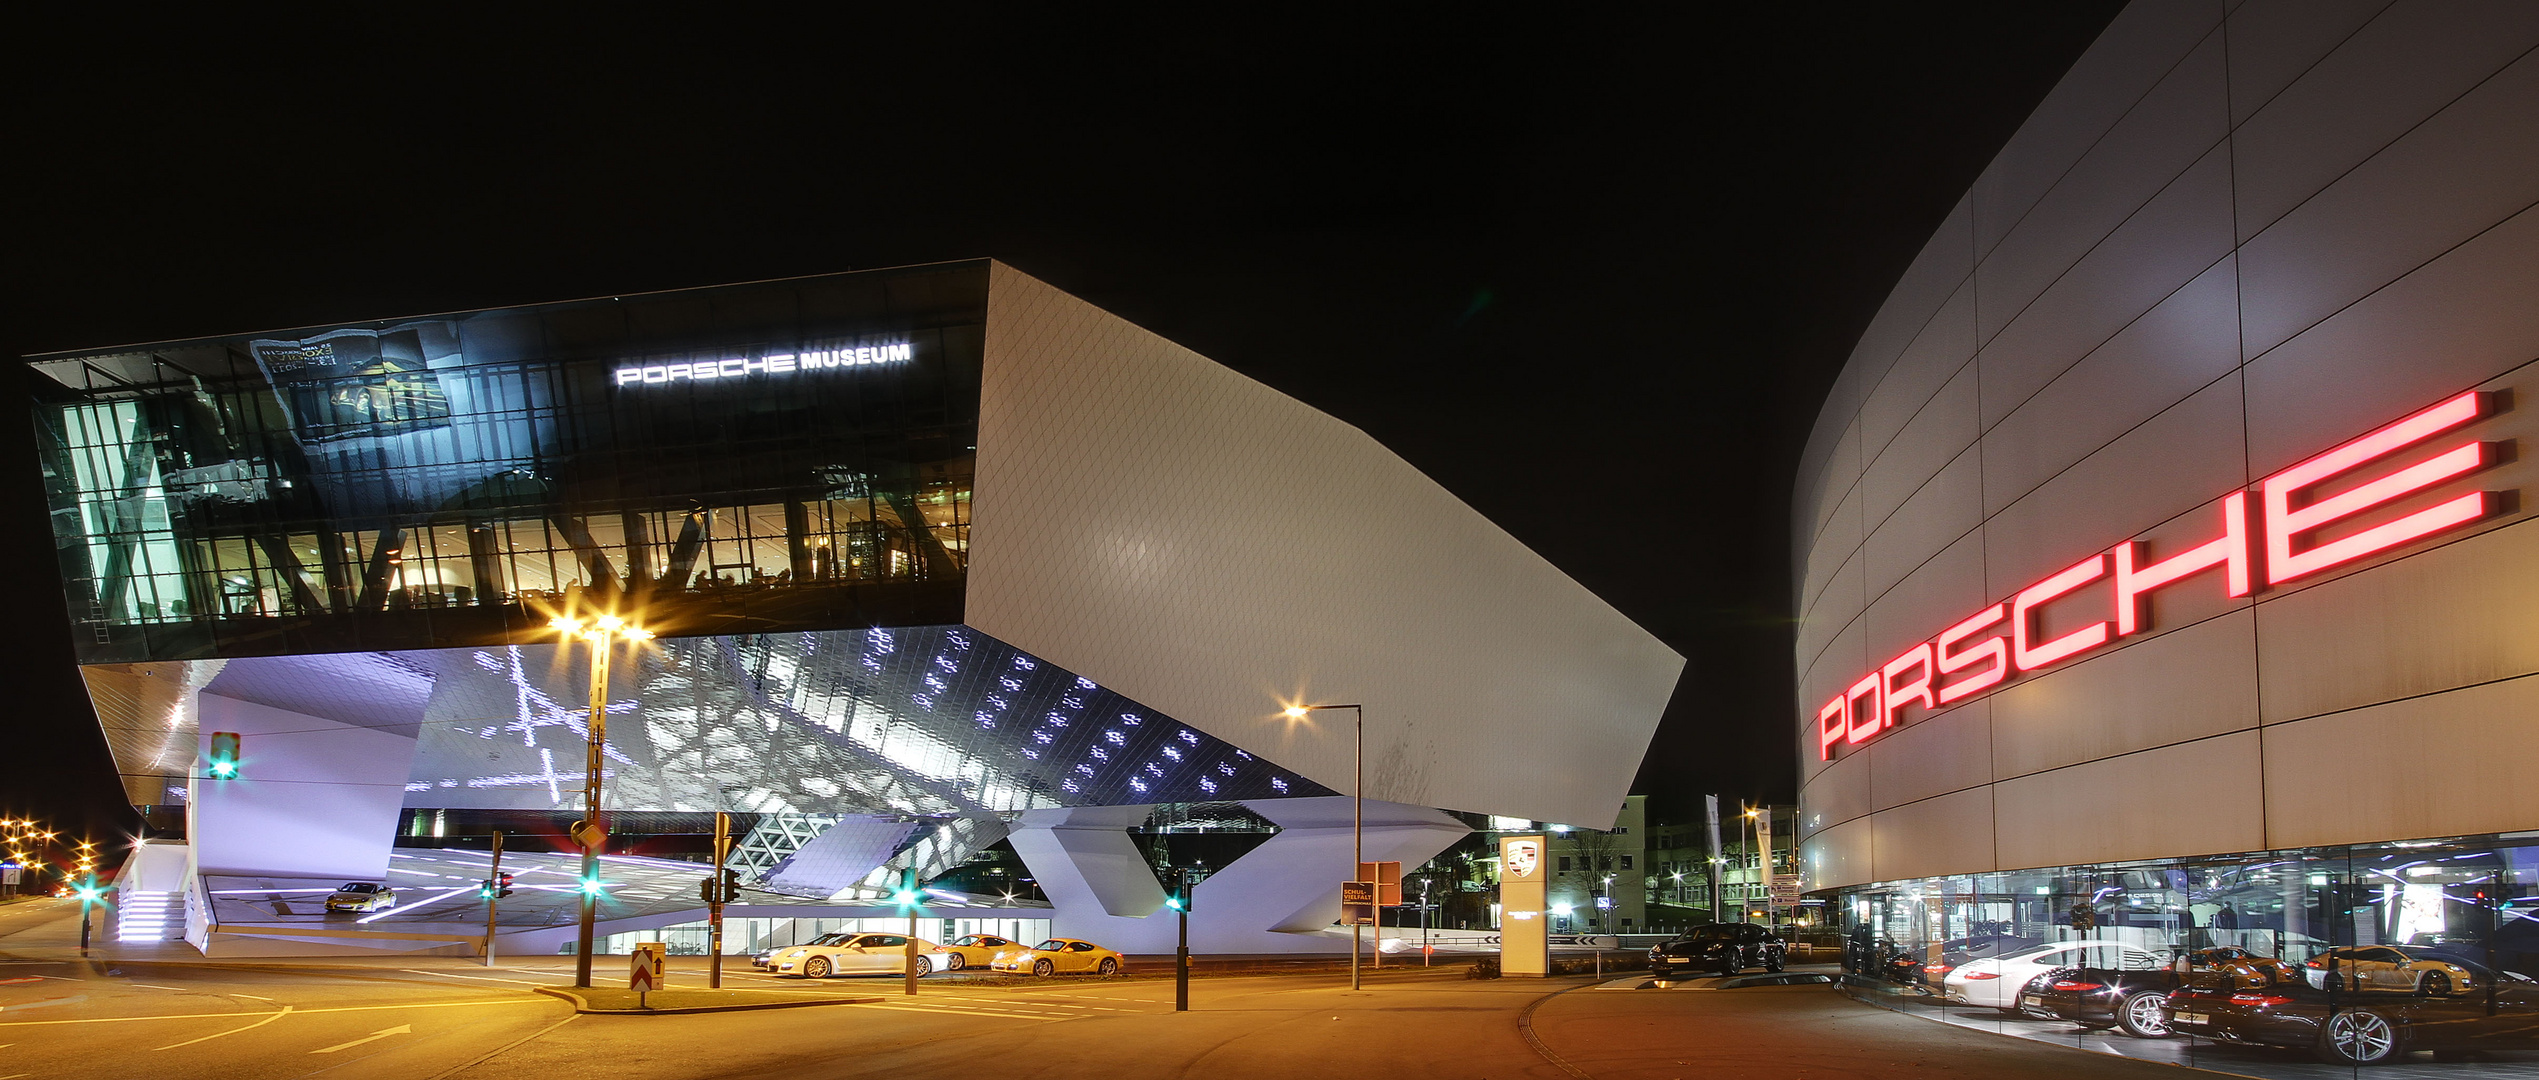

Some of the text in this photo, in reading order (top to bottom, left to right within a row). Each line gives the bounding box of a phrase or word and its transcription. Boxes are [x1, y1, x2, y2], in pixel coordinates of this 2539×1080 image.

[616, 343, 911, 386] PORSCHE MUSEUM
[1819, 390, 2485, 761] PORSCHE
